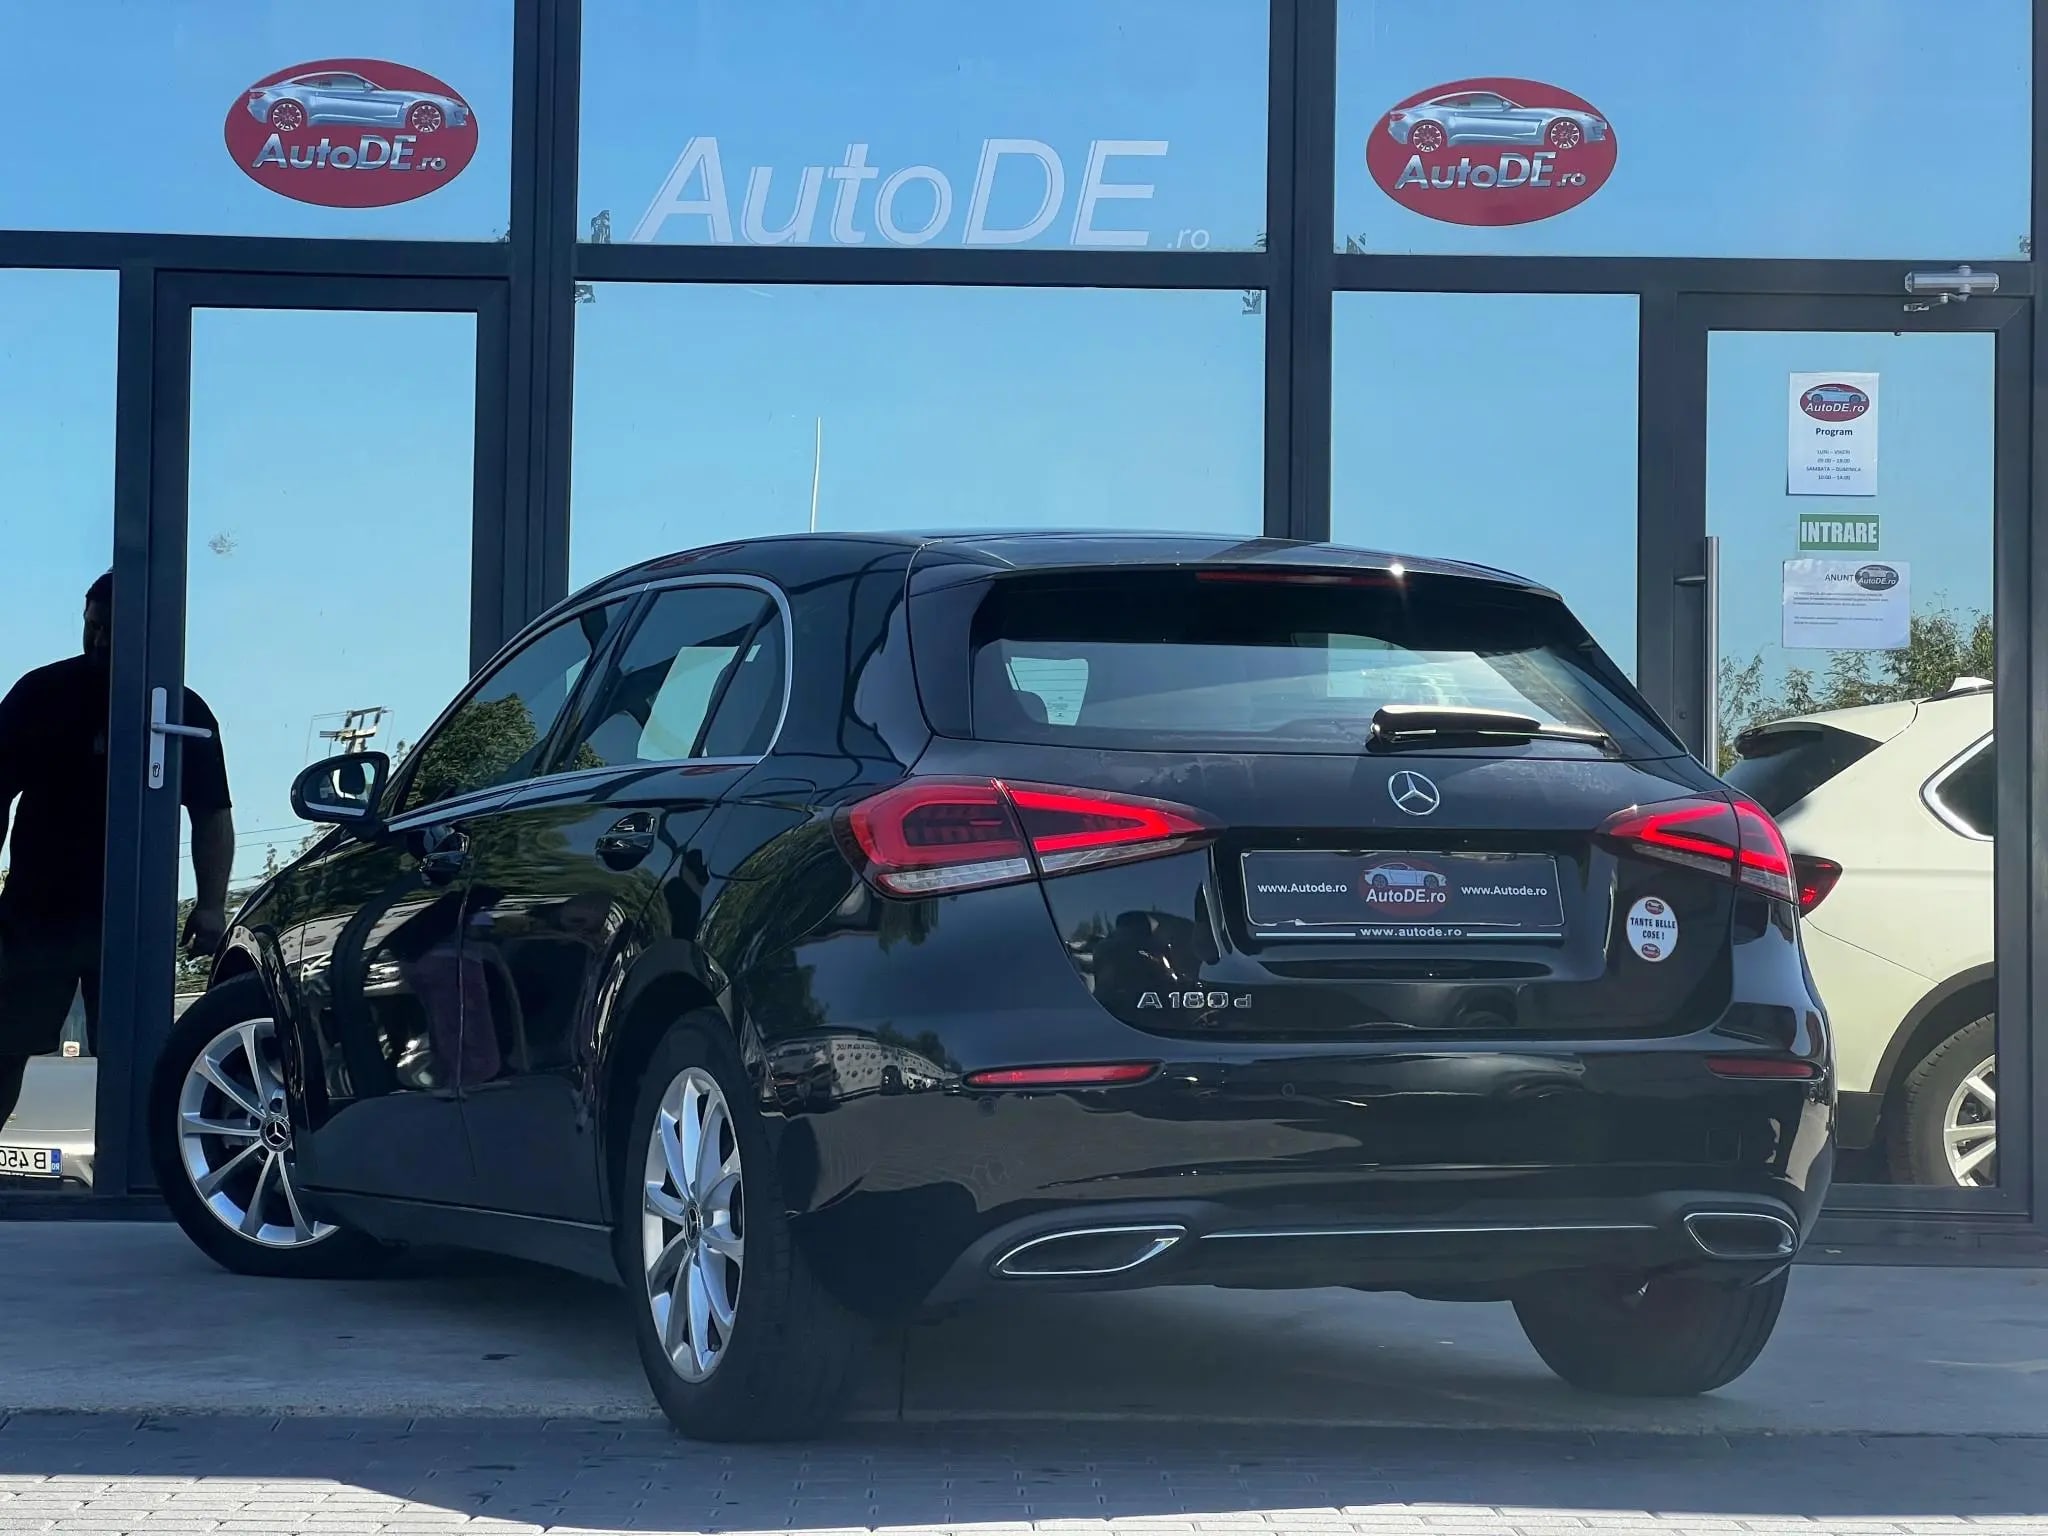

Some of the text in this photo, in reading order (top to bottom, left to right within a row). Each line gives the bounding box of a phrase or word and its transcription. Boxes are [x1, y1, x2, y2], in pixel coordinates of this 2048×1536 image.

[1805, 403, 1865, 413] AutoDE.ro
[1816, 428, 1853, 437] Program
[1801, 521, 1878, 543] INTRARE
[1257, 882, 1348, 893] www.Autode.ro
[1461, 885, 1548, 896] www.Autode.ro
[1365, 888, 1447, 903] AutoDE.ro
[1630, 917, 1676, 929] TANTE BELLE
[1359, 926, 1462, 937] www.autode.ro
[1642, 930, 1660, 939] COSE
